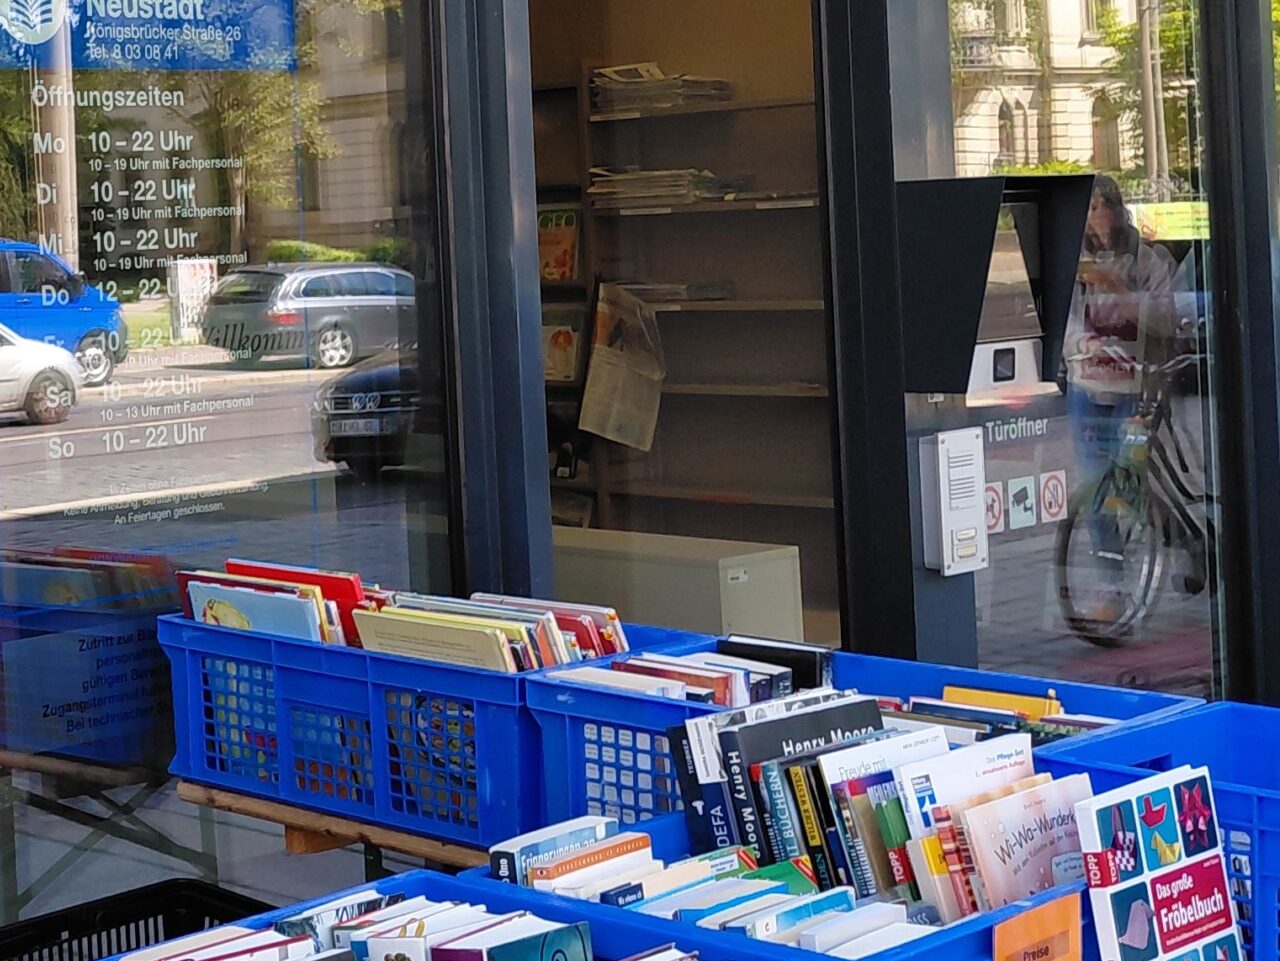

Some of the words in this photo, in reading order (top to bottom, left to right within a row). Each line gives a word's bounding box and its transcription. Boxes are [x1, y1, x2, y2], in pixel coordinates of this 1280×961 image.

[183, 23, 224, 41] Straße
[31, 82, 185, 112] Öffnungszeiten
[129, 157, 150, 171] Uhr
[172, 155, 244, 171] Fachpersonal
[133, 180, 157, 201] 22
[161, 178, 197, 201] Uhr
[131, 207, 152, 220] Uhr
[174, 204, 246, 219] Fachpersonal
[92, 230, 116, 253] 10
[136, 229, 160, 250] 22
[164, 228, 199, 249] Uhr
[41, 284, 70, 307] Do
[46, 385, 72, 408] Sa
[140, 405, 161, 418] Uhr
[163, 403, 181, 416] mit
[183, 395, 255, 414] Fachpersonal
[48, 437, 75, 460] So
[102, 430, 125, 453] 10
[145, 426, 169, 449] 22
[173, 422, 208, 444] Uhr
[984, 415, 1049, 444] Türöffner
[782, 733, 826, 757] Henry
[838, 760, 874, 780] Freude
[727, 750, 748, 802] Henry
[740, 806, 762, 860] Moore
[710, 804, 731, 848] DEFA
[889, 850, 905, 883] TOPP
[1086, 853, 1102, 887] TOPP
[1106, 851, 1118, 884] TOPP
[1155, 881, 1172, 901] Das
[1171, 872, 1195, 899] große
[1160, 886, 1226, 934] Fröbelbuch
